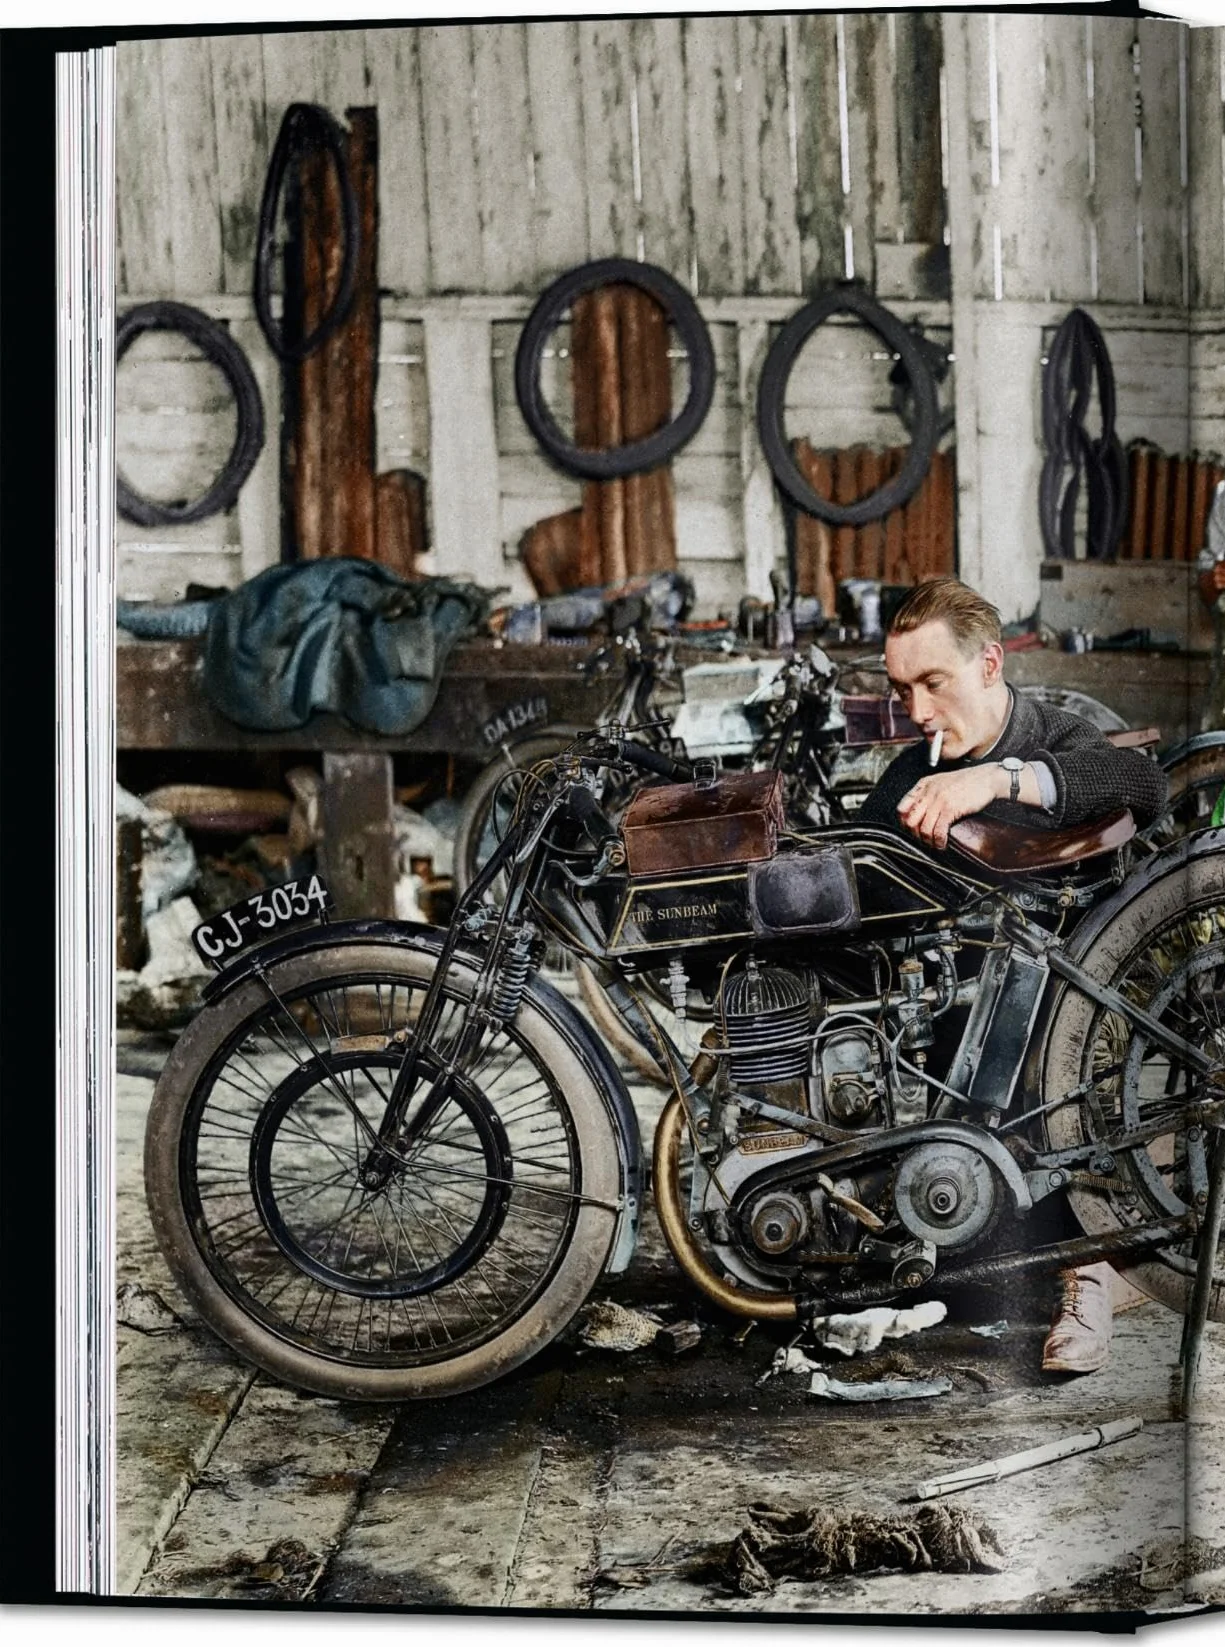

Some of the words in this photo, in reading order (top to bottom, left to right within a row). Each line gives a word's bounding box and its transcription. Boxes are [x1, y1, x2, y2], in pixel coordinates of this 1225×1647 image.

[197, 874, 328, 957] CJ-3034
[629, 911, 654, 922] THE
[657, 903, 718, 920] SUNBEAM
